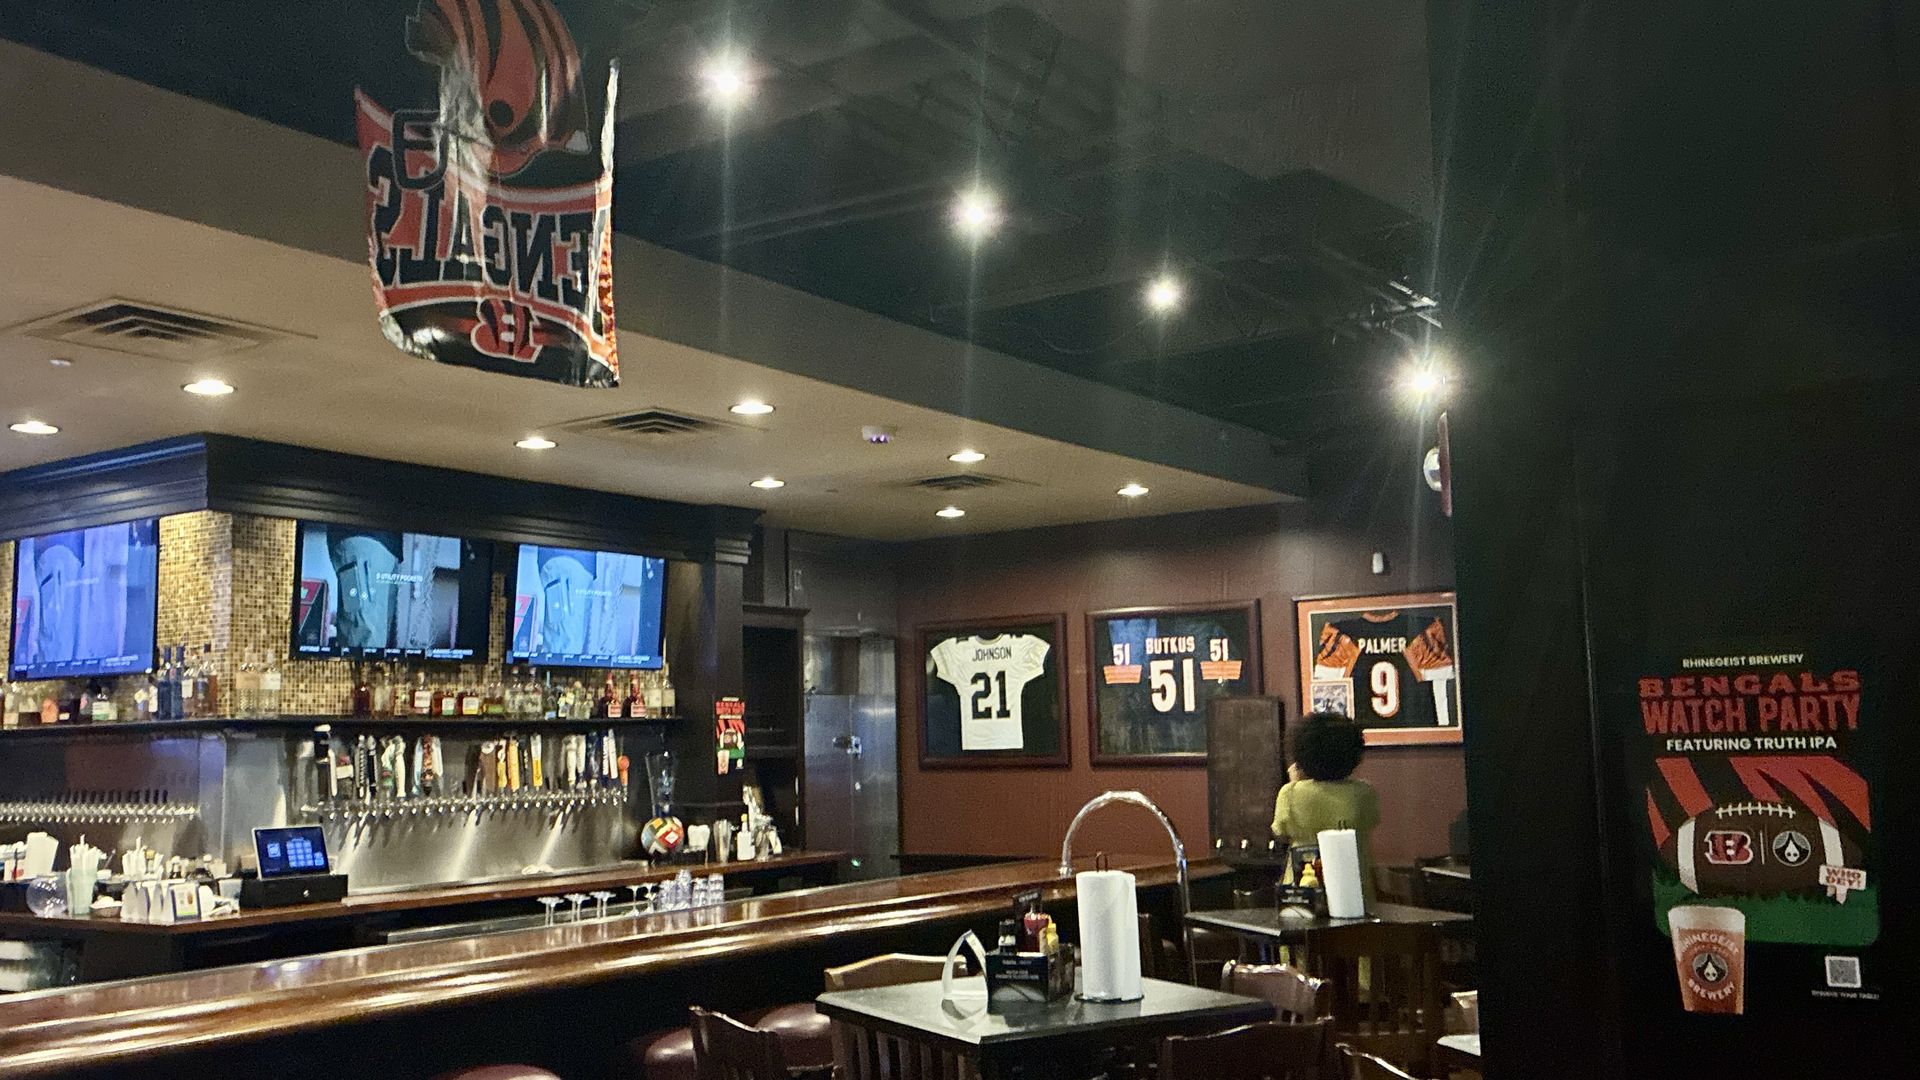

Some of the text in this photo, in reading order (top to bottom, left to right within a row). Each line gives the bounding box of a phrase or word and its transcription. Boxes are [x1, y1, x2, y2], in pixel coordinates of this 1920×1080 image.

[972, 646, 1012, 661] JOHNSON
[1113, 643, 1130, 665] 51
[1145, 636, 1195, 654] BUTKUS
[1209, 638, 1229, 661] 51
[1358, 636, 1406, 654] PALMER
[1682, 653, 1804, 668] RHINEGEIST BREWERY
[1150, 658, 1195, 712] 51
[1371, 661, 1399, 718] 9
[1638, 669, 1860, 697] BENGALS
[971, 670, 1011, 720] 21
[1641, 694, 1860, 735] WATCH PARTY
[1666, 736, 1837, 751] FEATURING TRUTH IPA
[1688, 978, 1735, 1000] BREWERY
